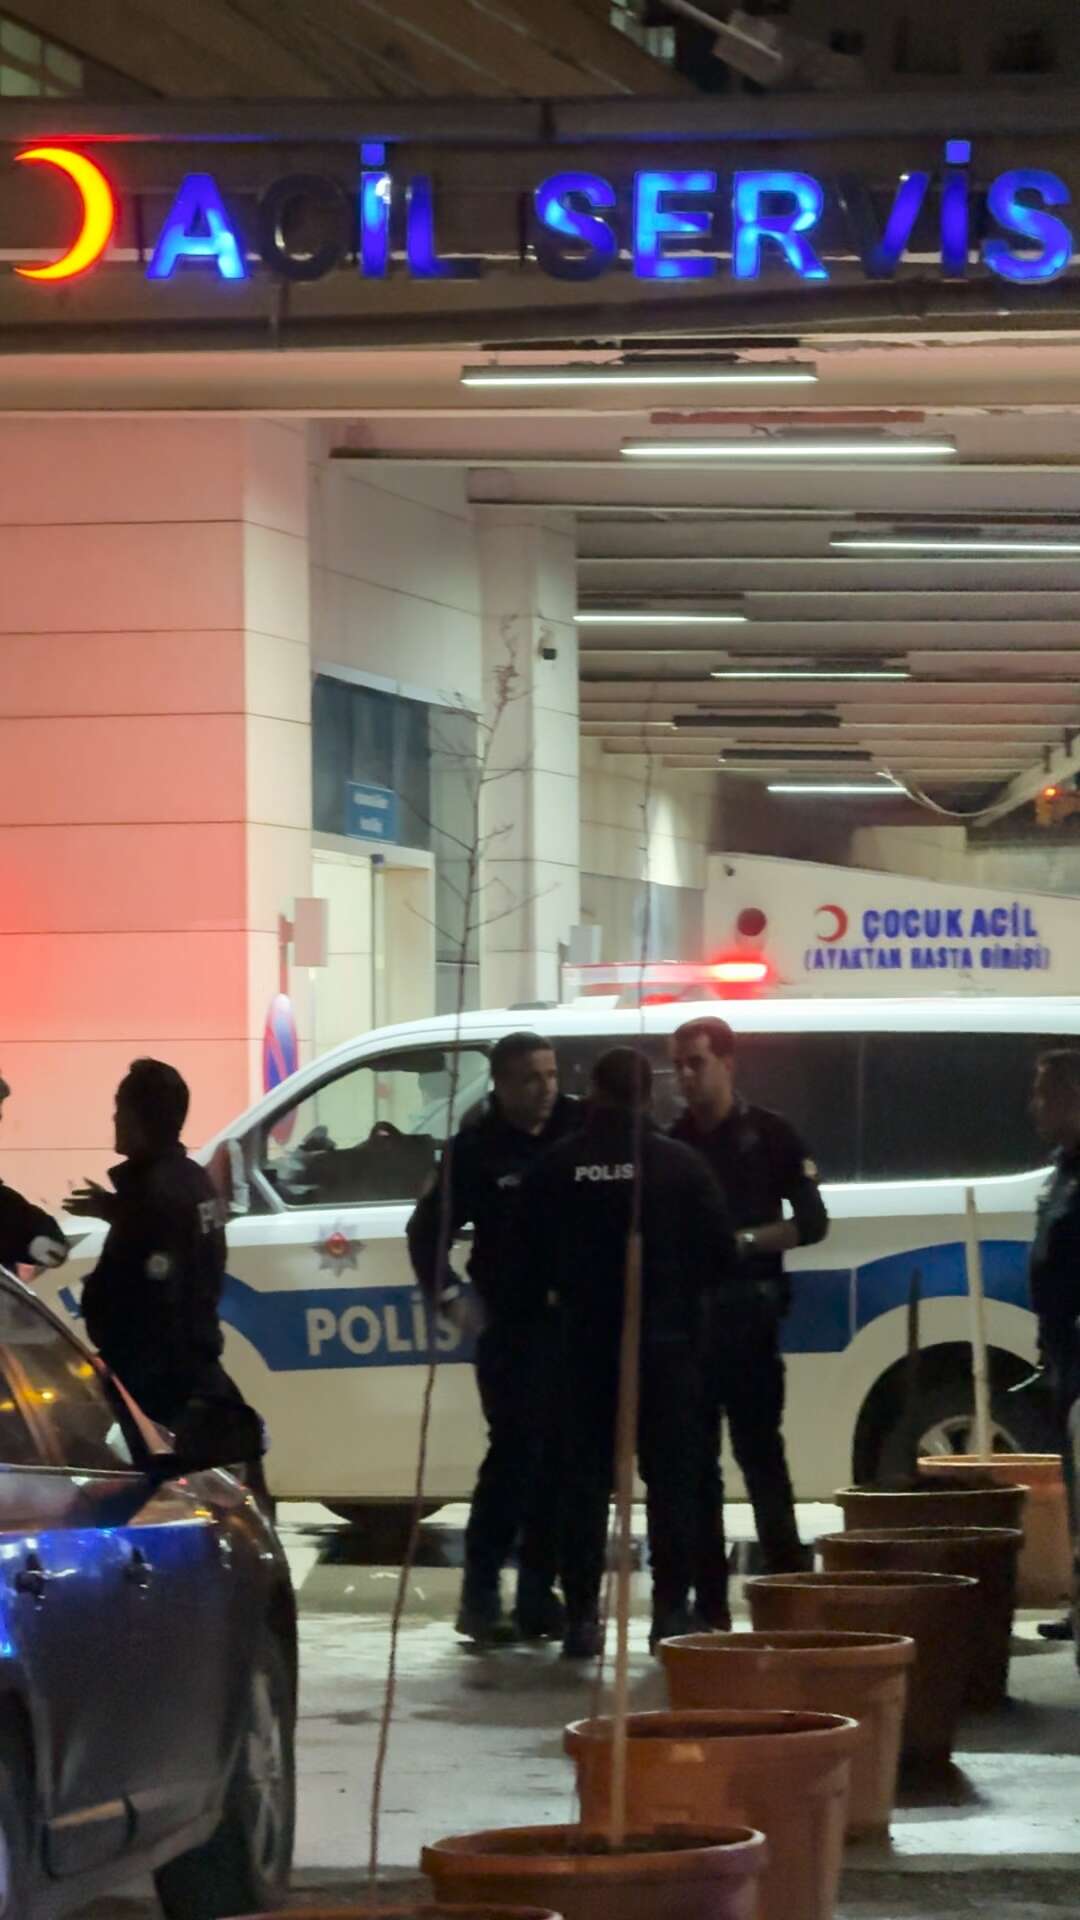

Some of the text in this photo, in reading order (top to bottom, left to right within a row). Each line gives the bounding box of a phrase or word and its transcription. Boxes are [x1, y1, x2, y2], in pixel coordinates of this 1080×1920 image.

[146, 139, 1073, 283] ACİL SERVİS
[862, 902, 1038, 942] ÇOCUK ACİL
[911, 946, 973, 970] HASTA
[306, 1290, 461, 1357] POLİS
